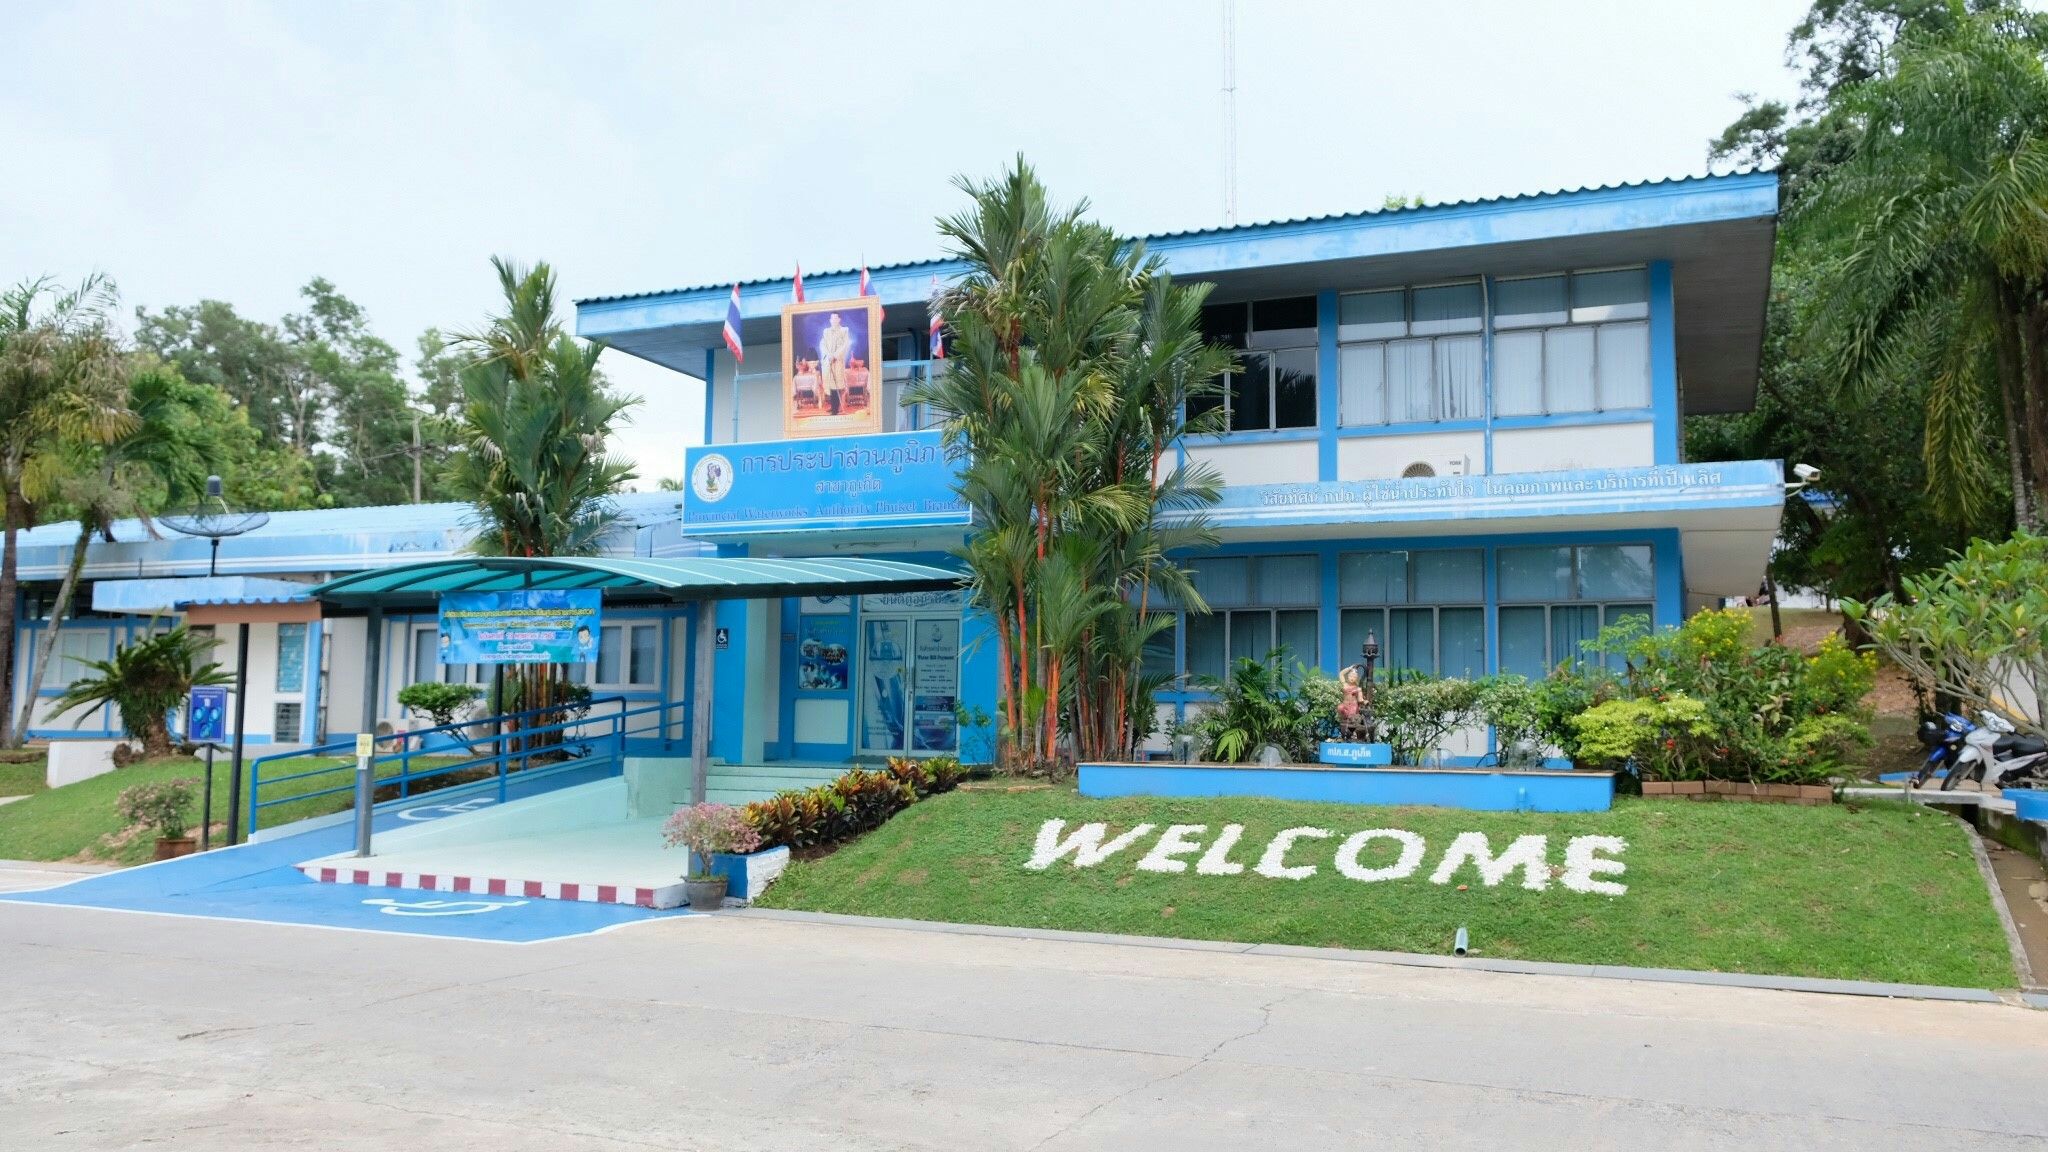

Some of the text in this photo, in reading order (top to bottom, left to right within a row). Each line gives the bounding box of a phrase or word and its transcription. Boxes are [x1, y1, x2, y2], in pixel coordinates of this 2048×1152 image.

[815, 471, 882, 497] สาขาภูเก็ต
[744, 506, 808, 520] Waterworks
[816, 502, 872, 517] Authority
[876, 500, 916, 513] Phuket
[1024, 818, 1629, 896] WELCOME
